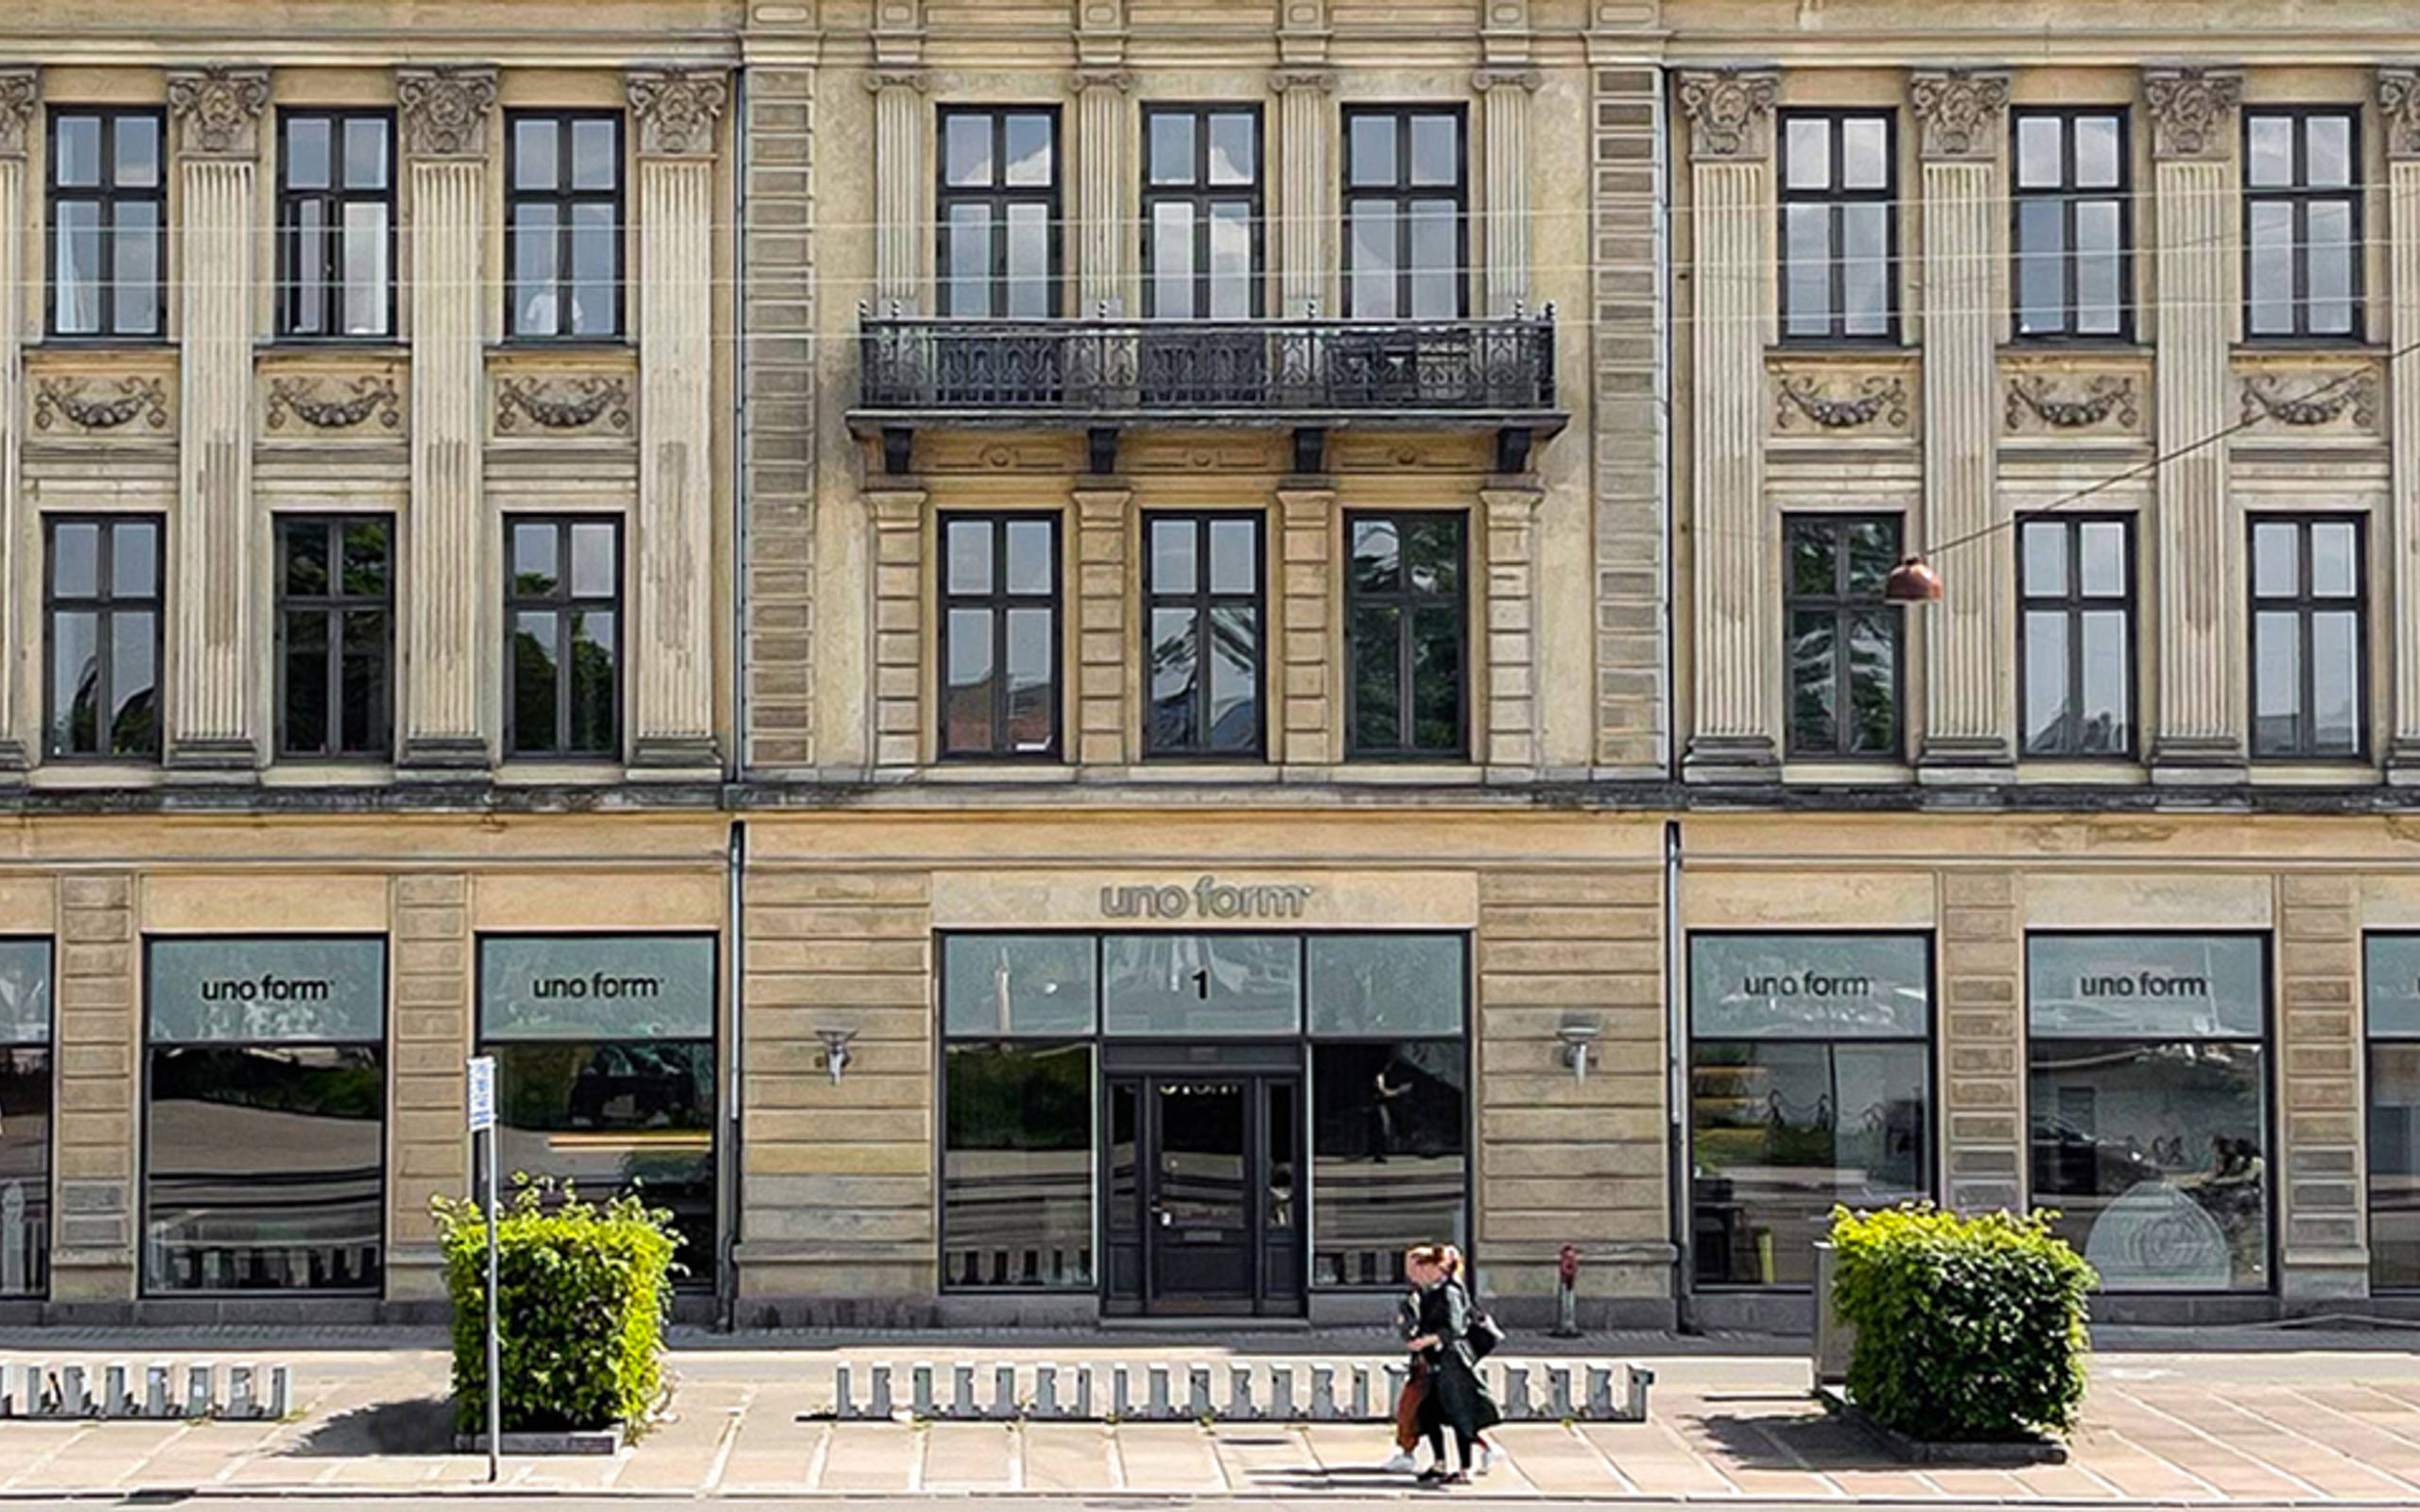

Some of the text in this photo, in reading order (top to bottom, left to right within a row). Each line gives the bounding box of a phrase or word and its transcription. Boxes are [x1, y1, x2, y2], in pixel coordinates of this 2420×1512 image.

[1100, 875, 1304, 918] uno form
[202, 973, 329, 1000] uno form
[533, 971, 659, 998] uno form
[1192, 970, 1207, 1000] 1
[1744, 971, 1869, 996] uno form
[2081, 971, 2206, 996] uno form
